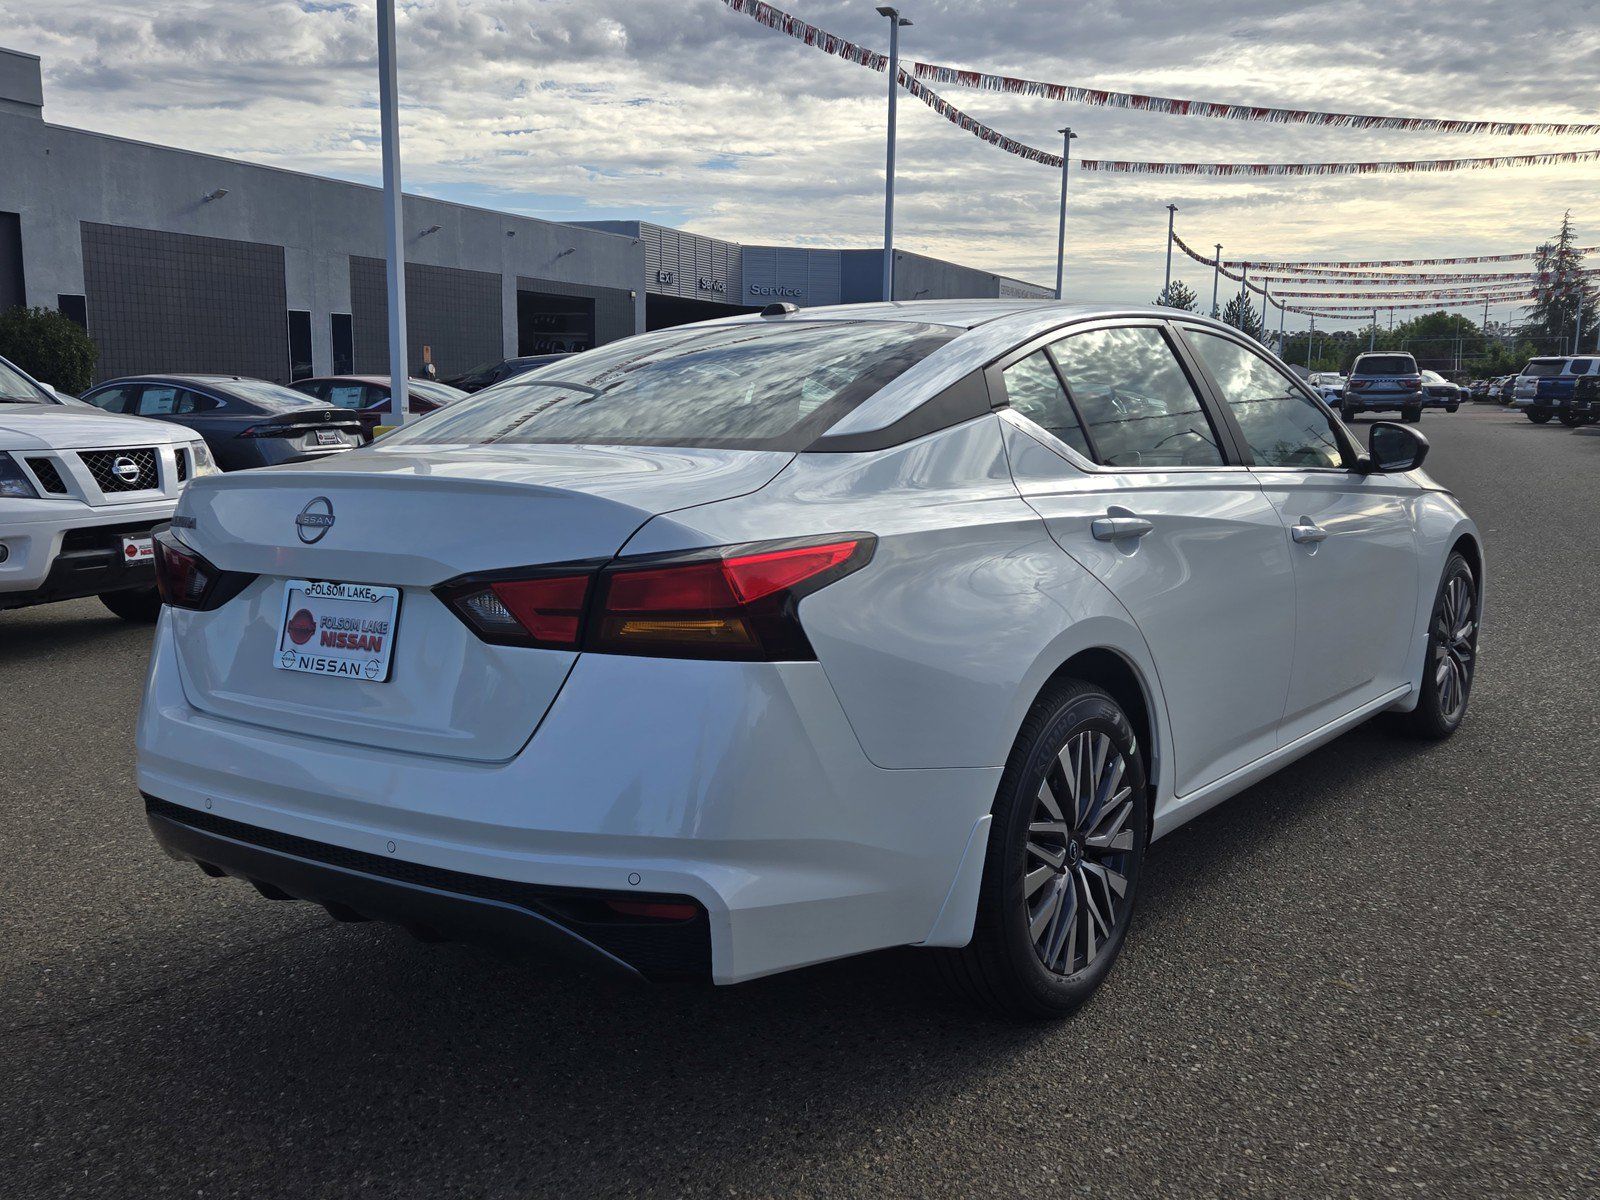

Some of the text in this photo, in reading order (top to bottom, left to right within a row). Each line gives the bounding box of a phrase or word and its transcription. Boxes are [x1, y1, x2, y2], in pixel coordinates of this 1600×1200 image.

[658, 270, 677, 284] Exit
[701, 277, 727, 293] Service
[750, 283, 801, 297] Service
[311, 584, 371, 599] FOLSOM LAKE
[320, 615, 361, 631] FOLSOM
[361, 620, 388, 634] LAKE
[320, 630, 383, 653] NISSAN
[299, 656, 361, 676] NISSAN
